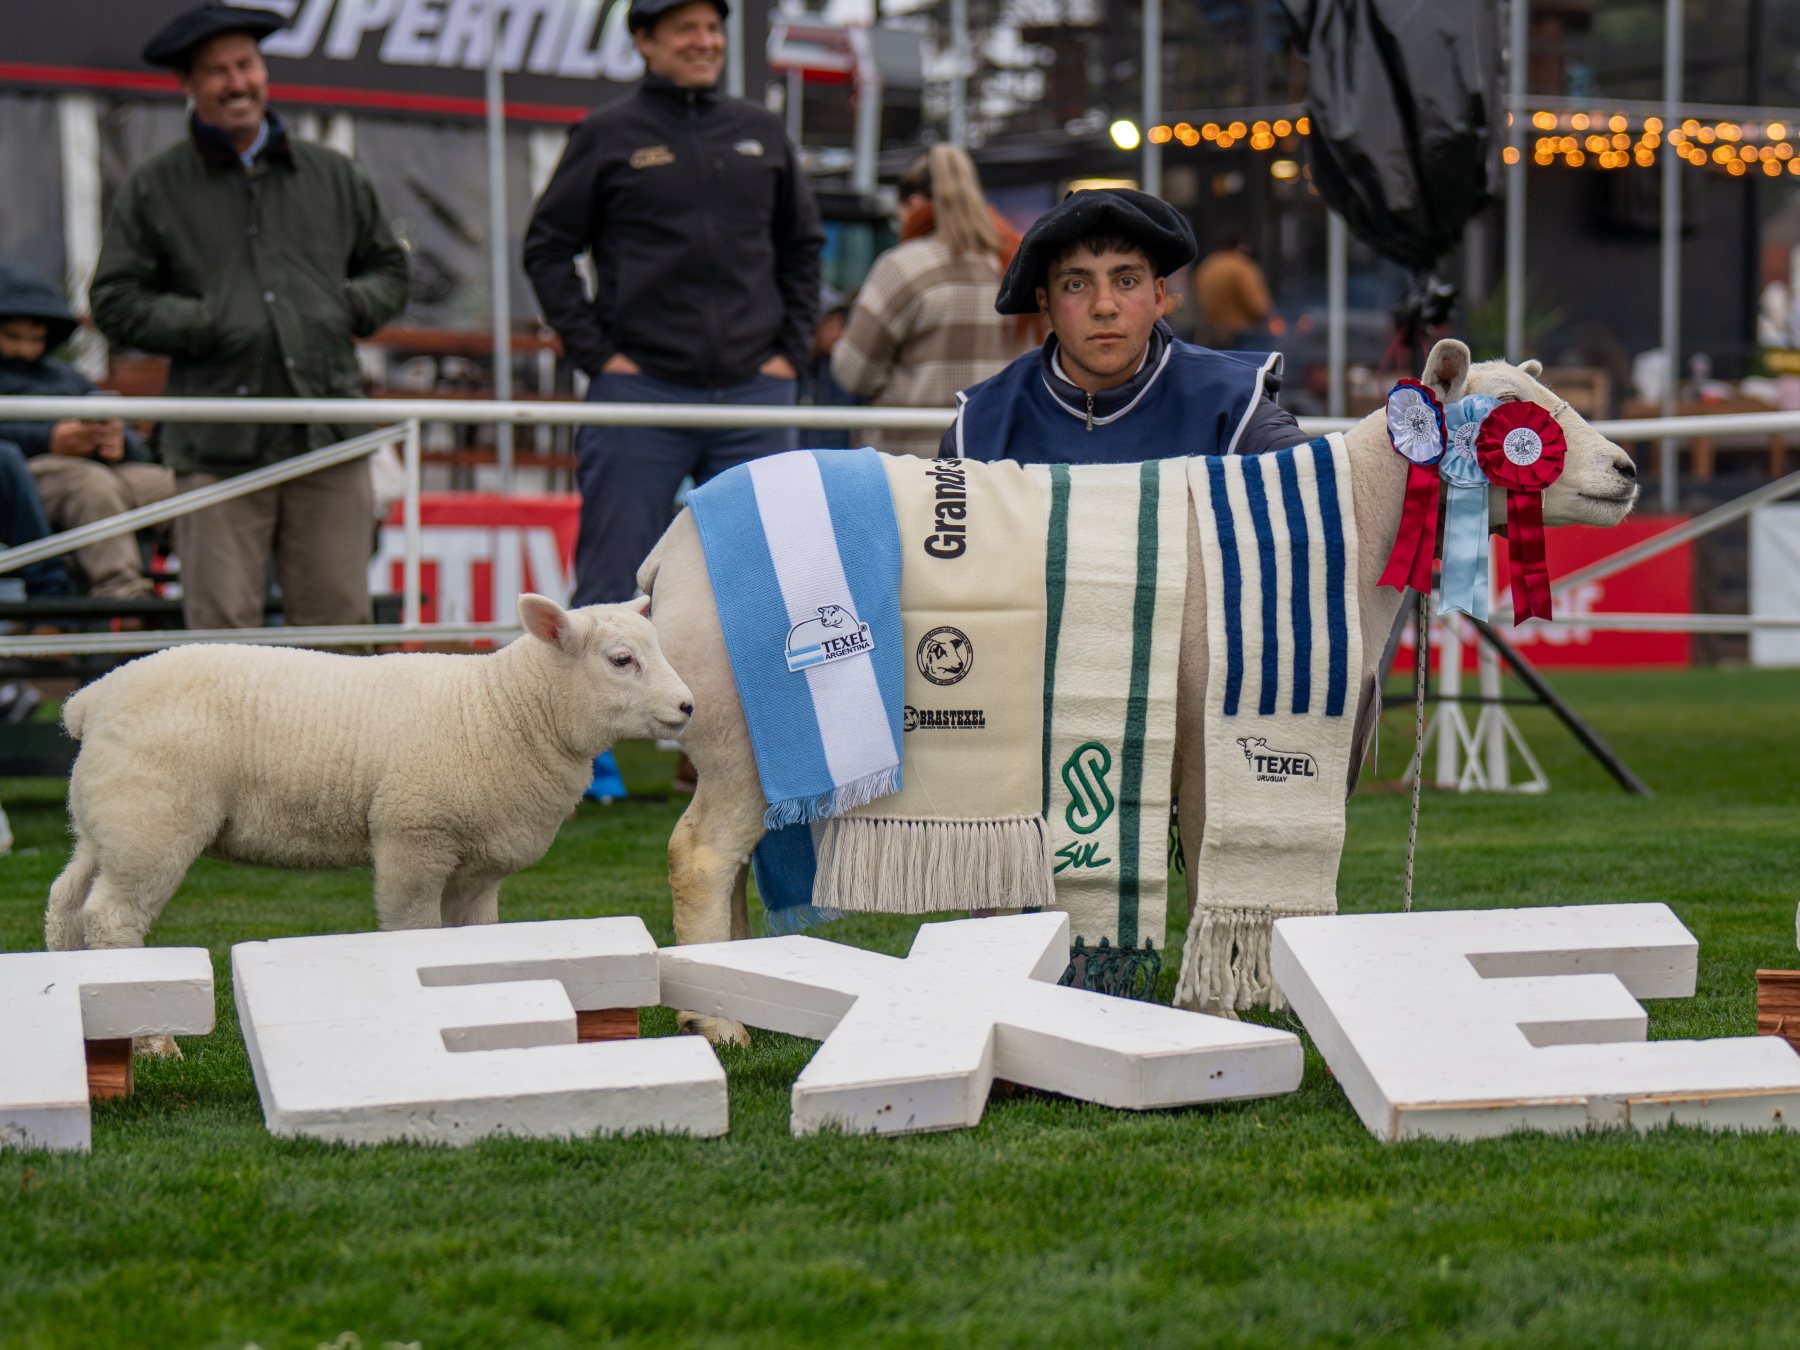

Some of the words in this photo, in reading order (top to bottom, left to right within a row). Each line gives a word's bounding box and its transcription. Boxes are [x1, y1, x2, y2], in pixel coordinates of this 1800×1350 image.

[821, 631, 867, 653] TEXEL
[825, 642, 870, 660] ARGENTINA
[919, 709, 986, 726] BRASTEXEL
[1254, 755, 1314, 777] TEXEL
[1256, 774, 1288, 783] URUGUAY
[1054, 841, 1111, 874] SUL
[0, 903, 1800, 1151] TEXE
